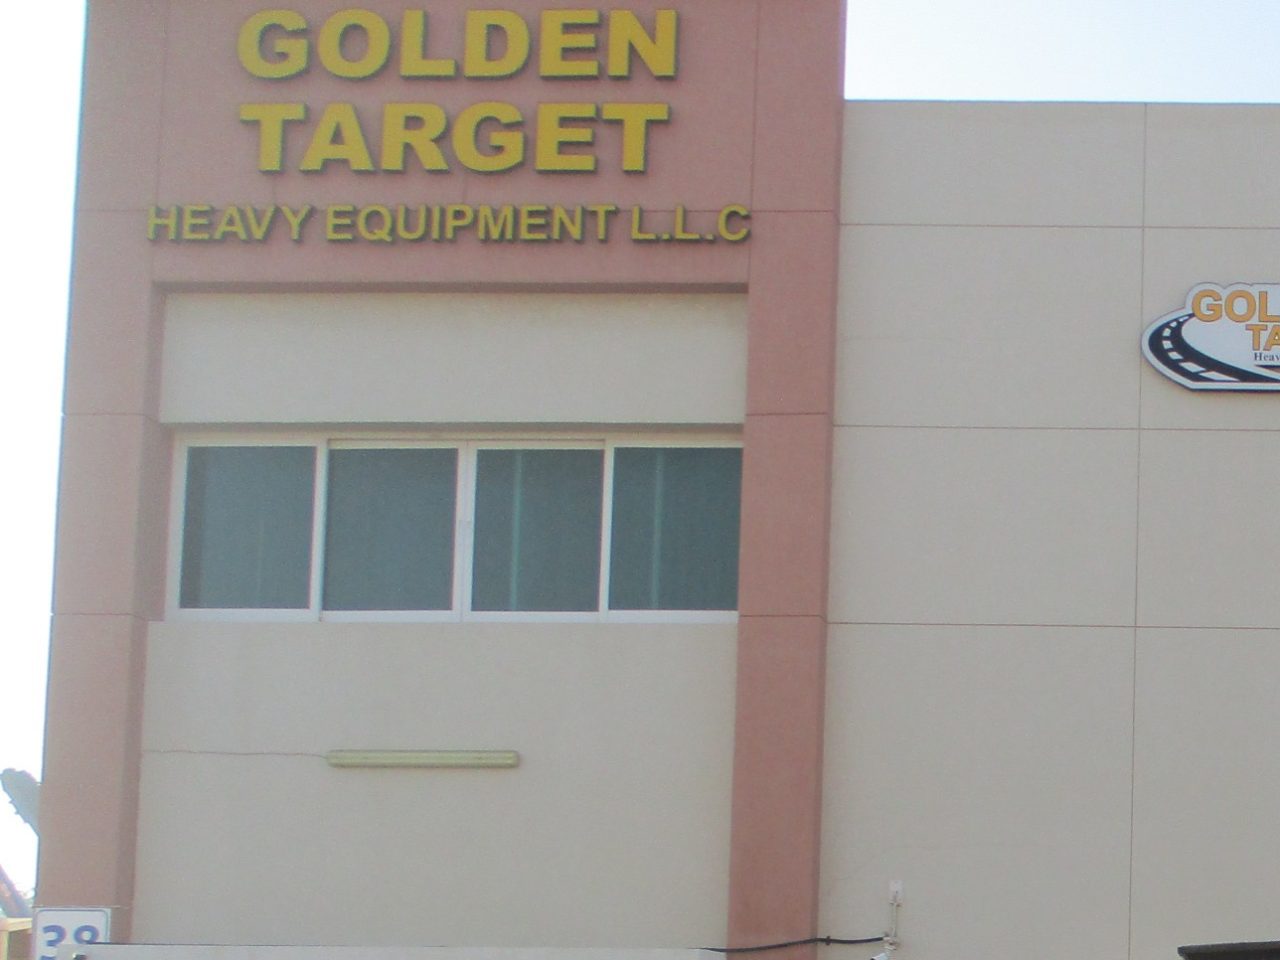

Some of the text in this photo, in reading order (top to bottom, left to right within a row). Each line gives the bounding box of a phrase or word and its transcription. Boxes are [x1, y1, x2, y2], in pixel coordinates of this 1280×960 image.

[236, 8, 680, 81] GOLDEN
[239, 101, 671, 175] TARGET
[146, 204, 751, 244] HEAVY EQUIPMENT L.L.C
